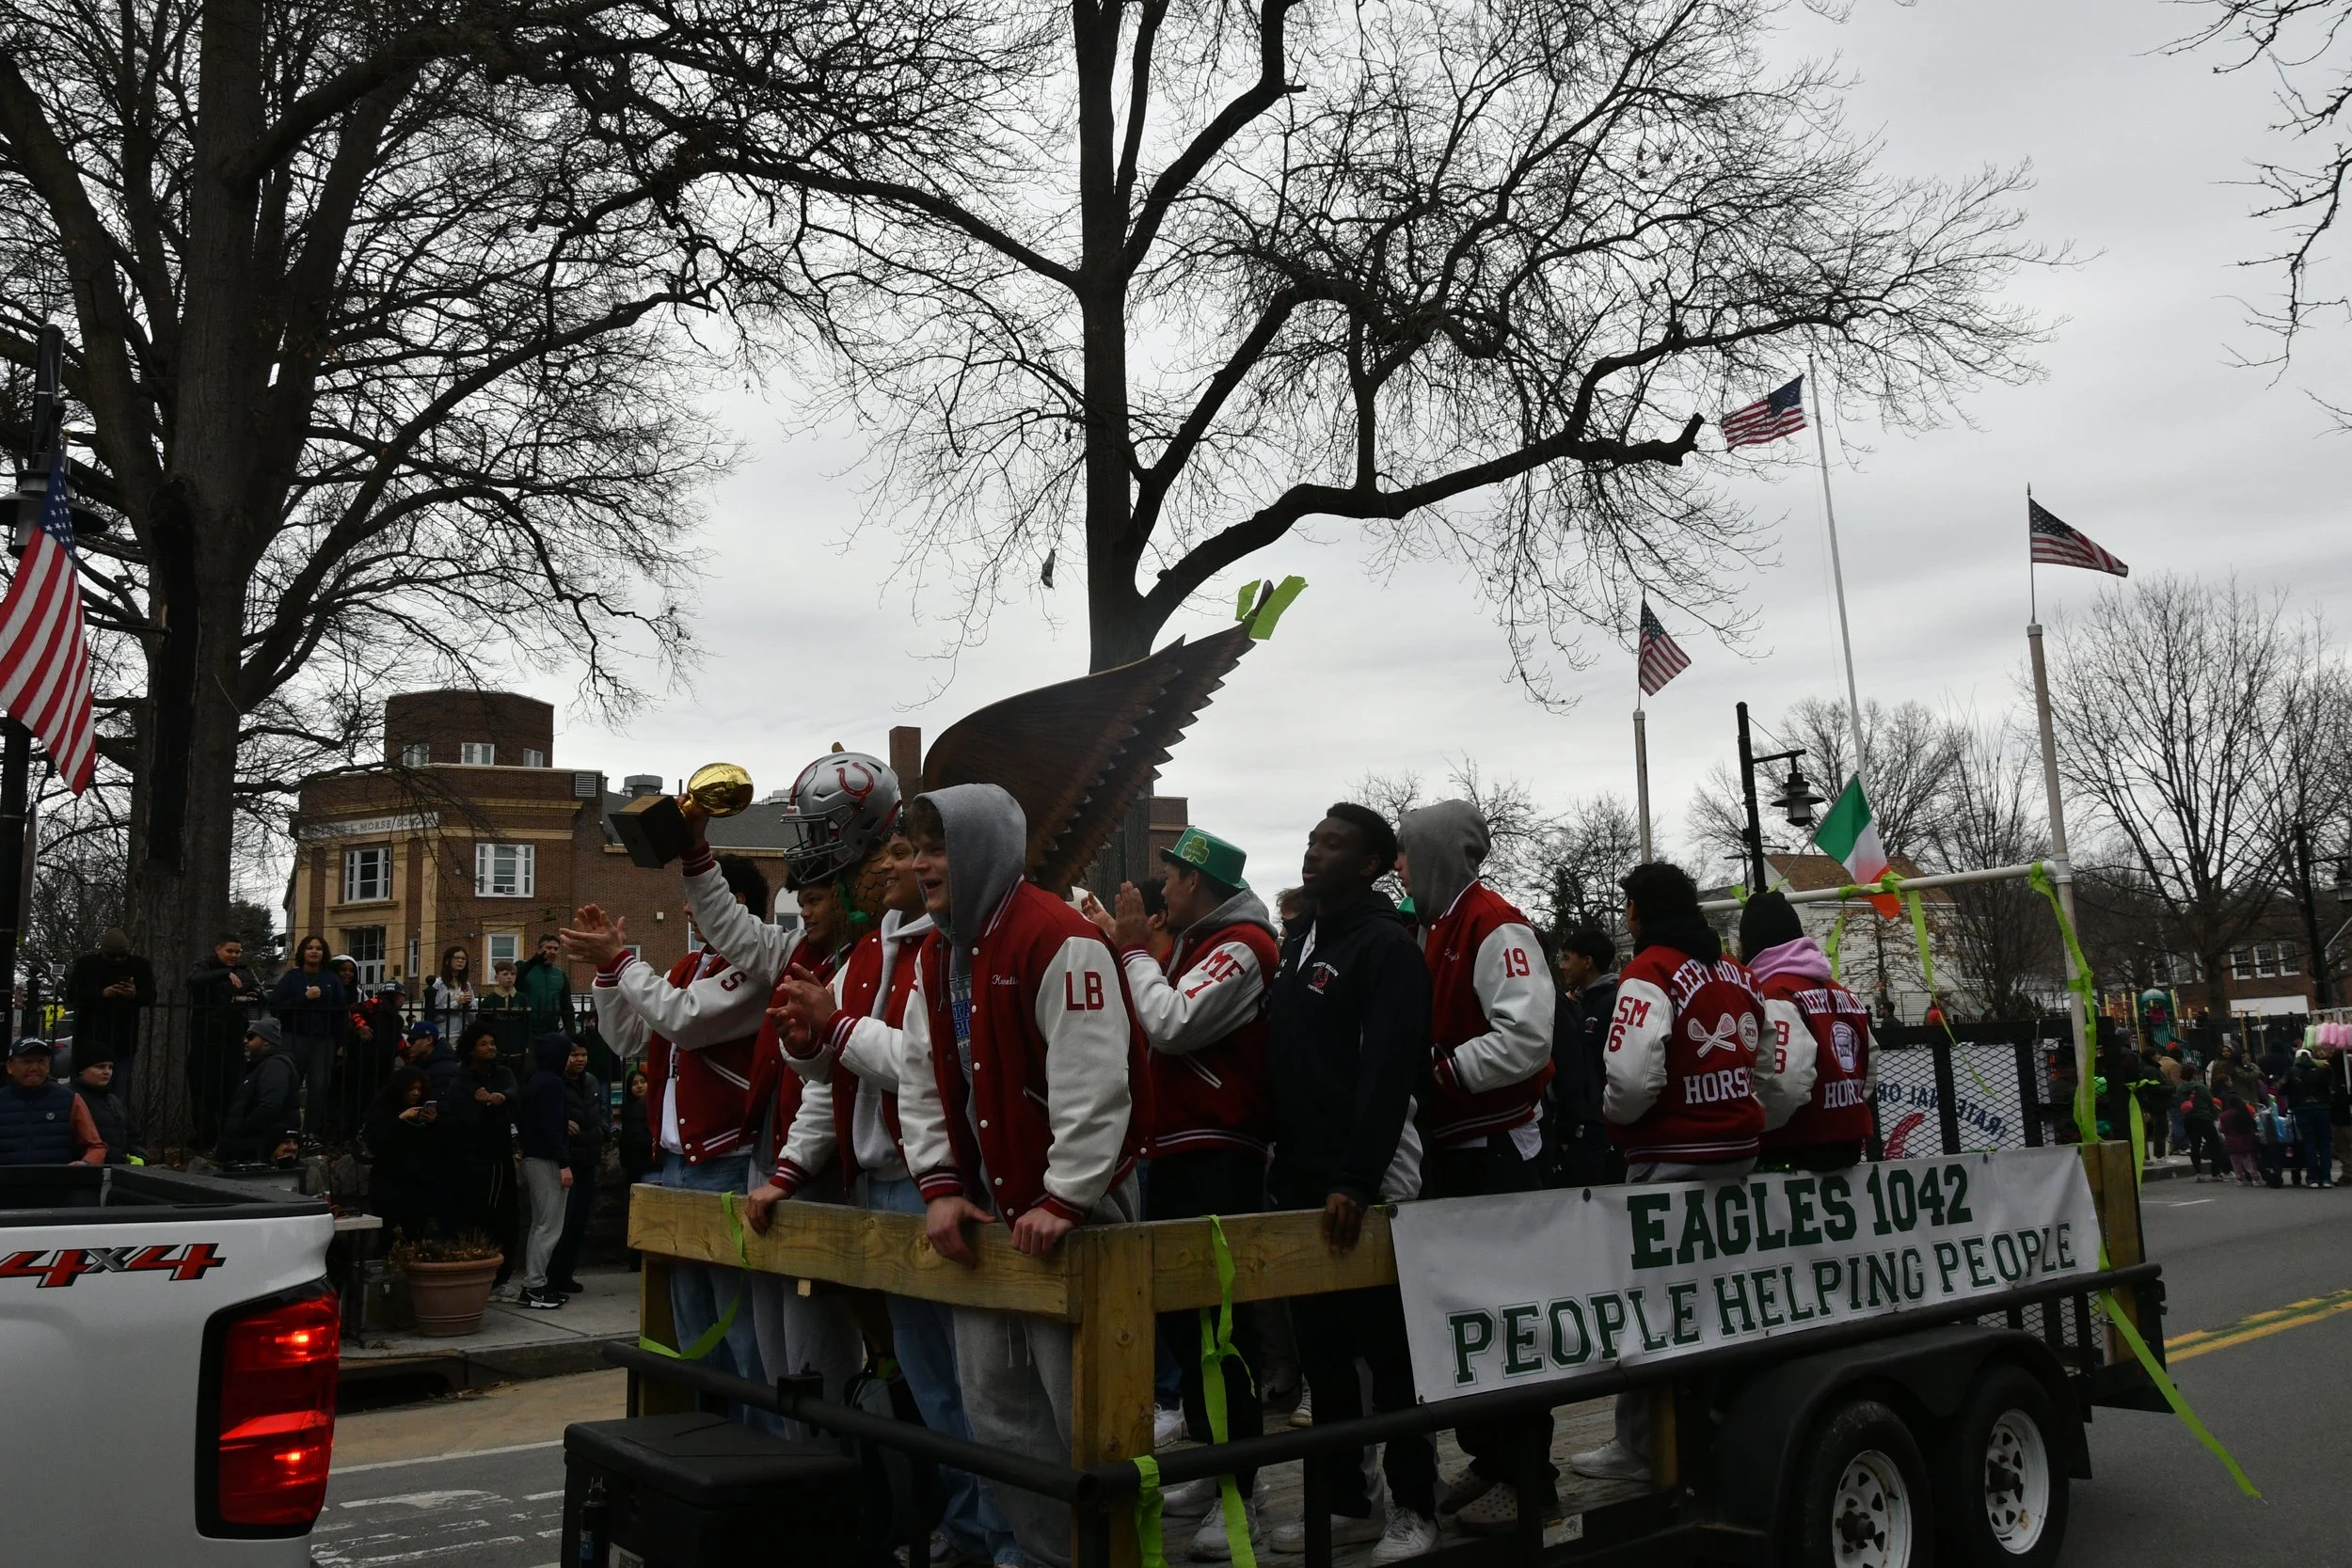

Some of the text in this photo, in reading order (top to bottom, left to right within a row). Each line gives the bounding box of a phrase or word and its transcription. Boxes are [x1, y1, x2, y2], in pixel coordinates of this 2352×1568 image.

[360, 819, 391, 832] MORSE
[1200, 950, 1246, 982] MF
[1503, 948, 1530, 977] 19
[721, 971, 747, 991] S
[1066, 972, 1104, 1011] LB
[1184, 980, 1214, 999] 1
[1611, 996, 1651, 1028] SM
[1609, 1024, 1626, 1053] 6
[1628, 1164, 1973, 1270] EAGLES 1042
[1446, 1219, 2077, 1387] PEOPLE HELPING PEOPLE
